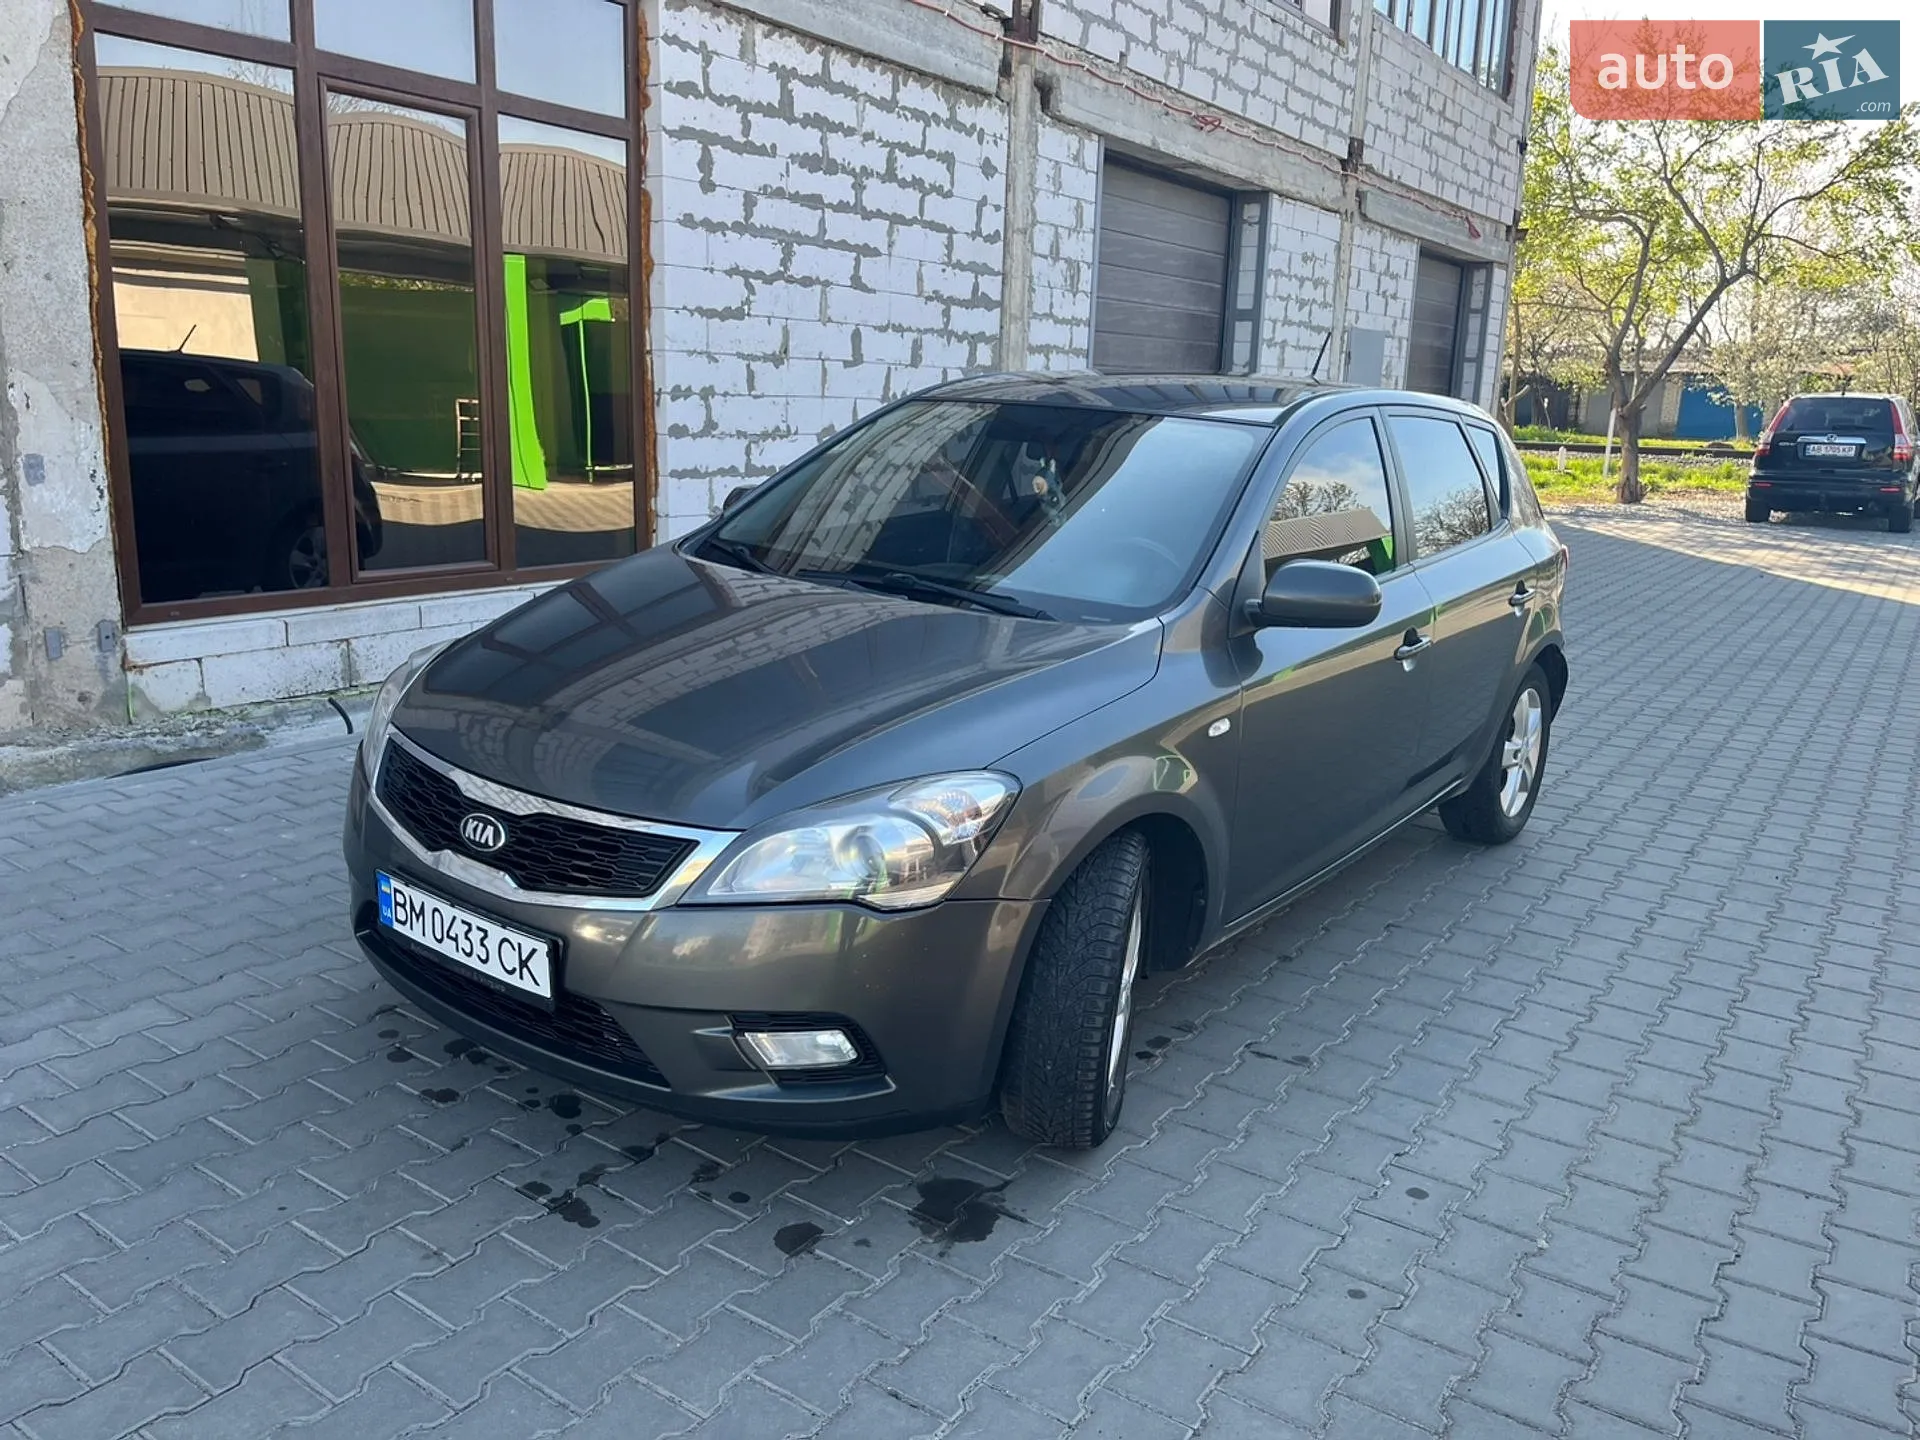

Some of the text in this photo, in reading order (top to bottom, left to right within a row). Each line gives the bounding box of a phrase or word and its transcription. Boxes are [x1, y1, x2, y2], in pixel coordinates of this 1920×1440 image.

[465, 818, 494, 847] KIA
[382, 904, 392, 919] UA
[393, 886, 425, 938] BM
[432, 907, 490, 965] 0433
[497, 937, 541, 987] CK
